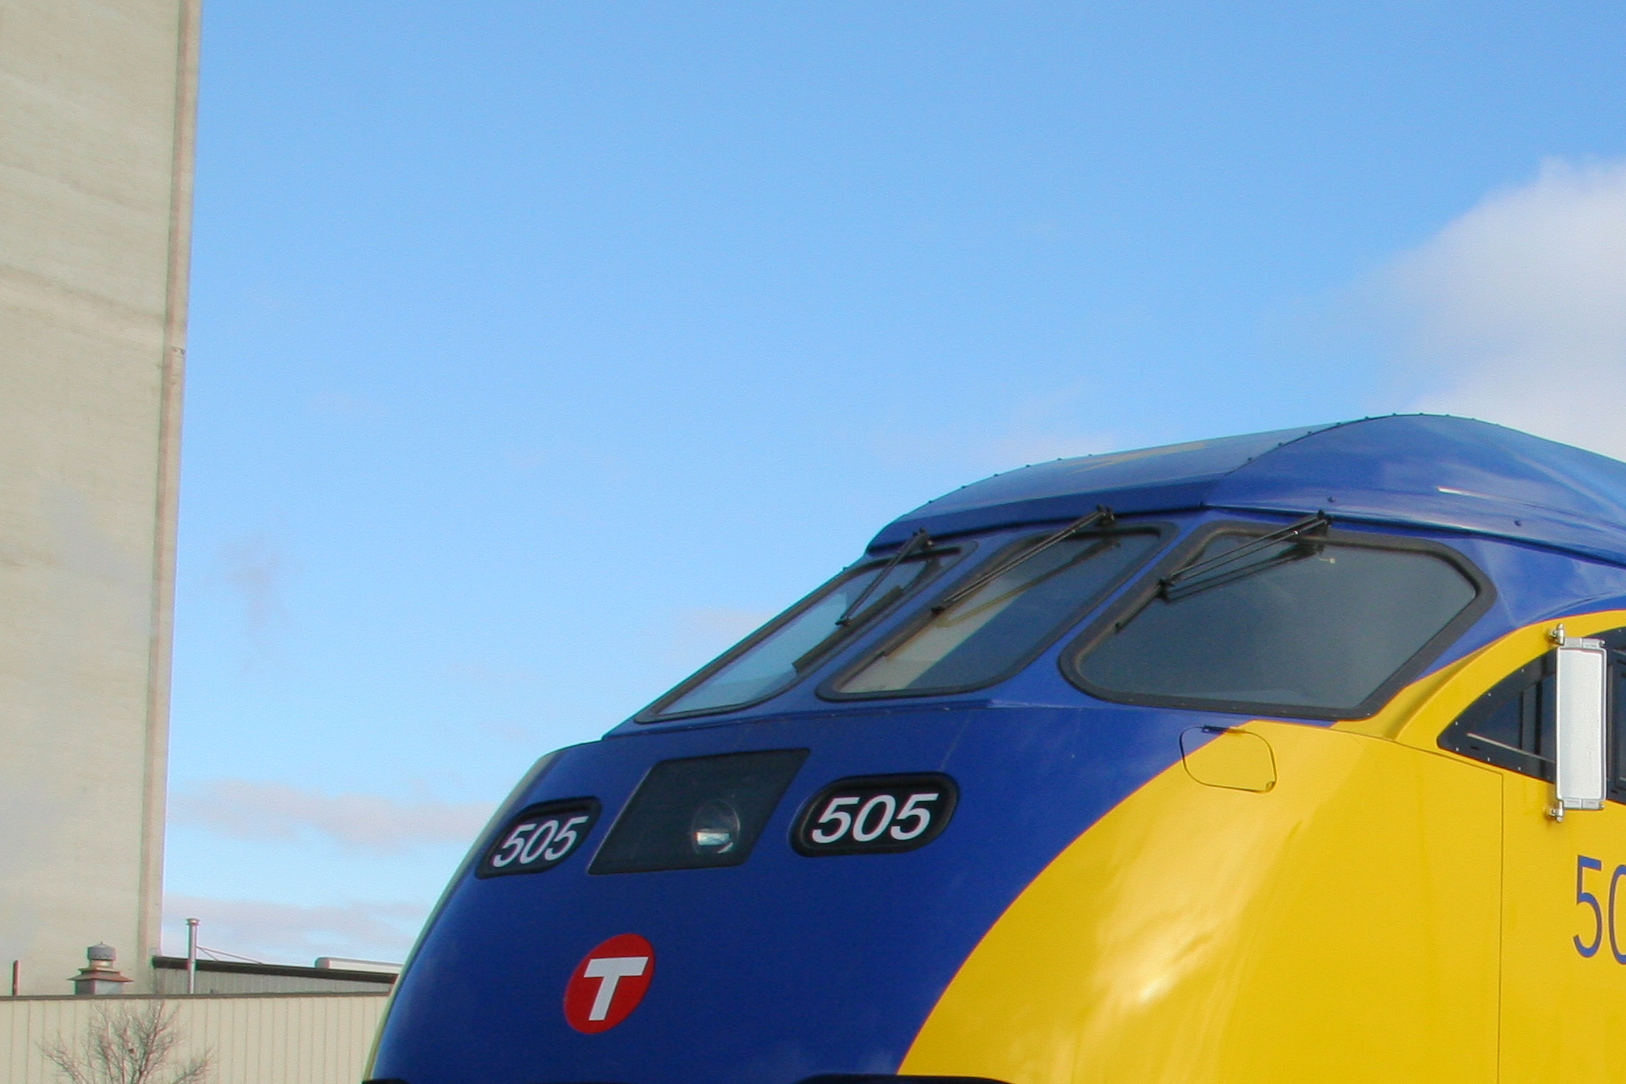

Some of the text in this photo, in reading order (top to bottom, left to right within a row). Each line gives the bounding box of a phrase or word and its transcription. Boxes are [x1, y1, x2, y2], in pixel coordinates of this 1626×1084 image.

[493, 815, 588, 868] 505
[812, 793, 939, 844] 505
[584, 956, 649, 1021] T
